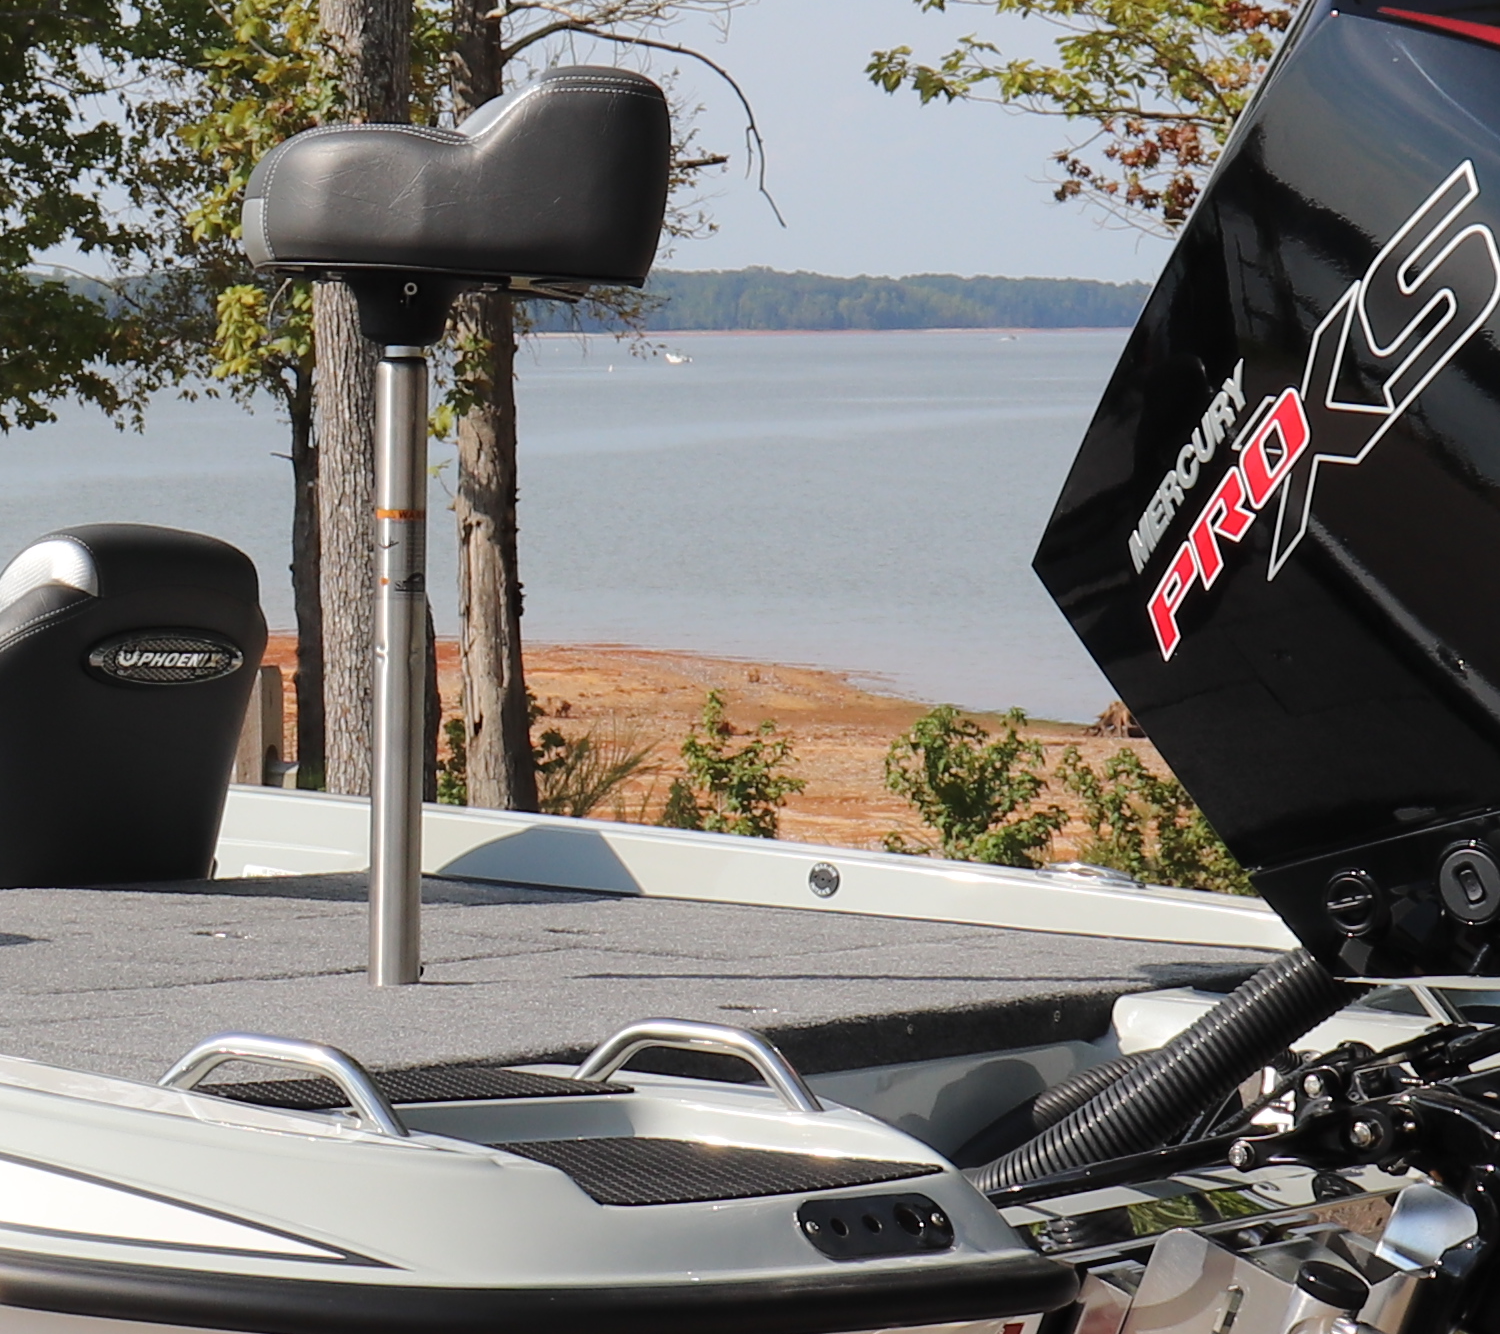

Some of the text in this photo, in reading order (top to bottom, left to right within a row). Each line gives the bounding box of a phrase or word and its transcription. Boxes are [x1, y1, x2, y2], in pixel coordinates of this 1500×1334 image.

[1127, 358, 1248, 575] MERCURY
[1146, 386, 1311, 663] PRO
[137, 652, 222, 668] PHOENIX
